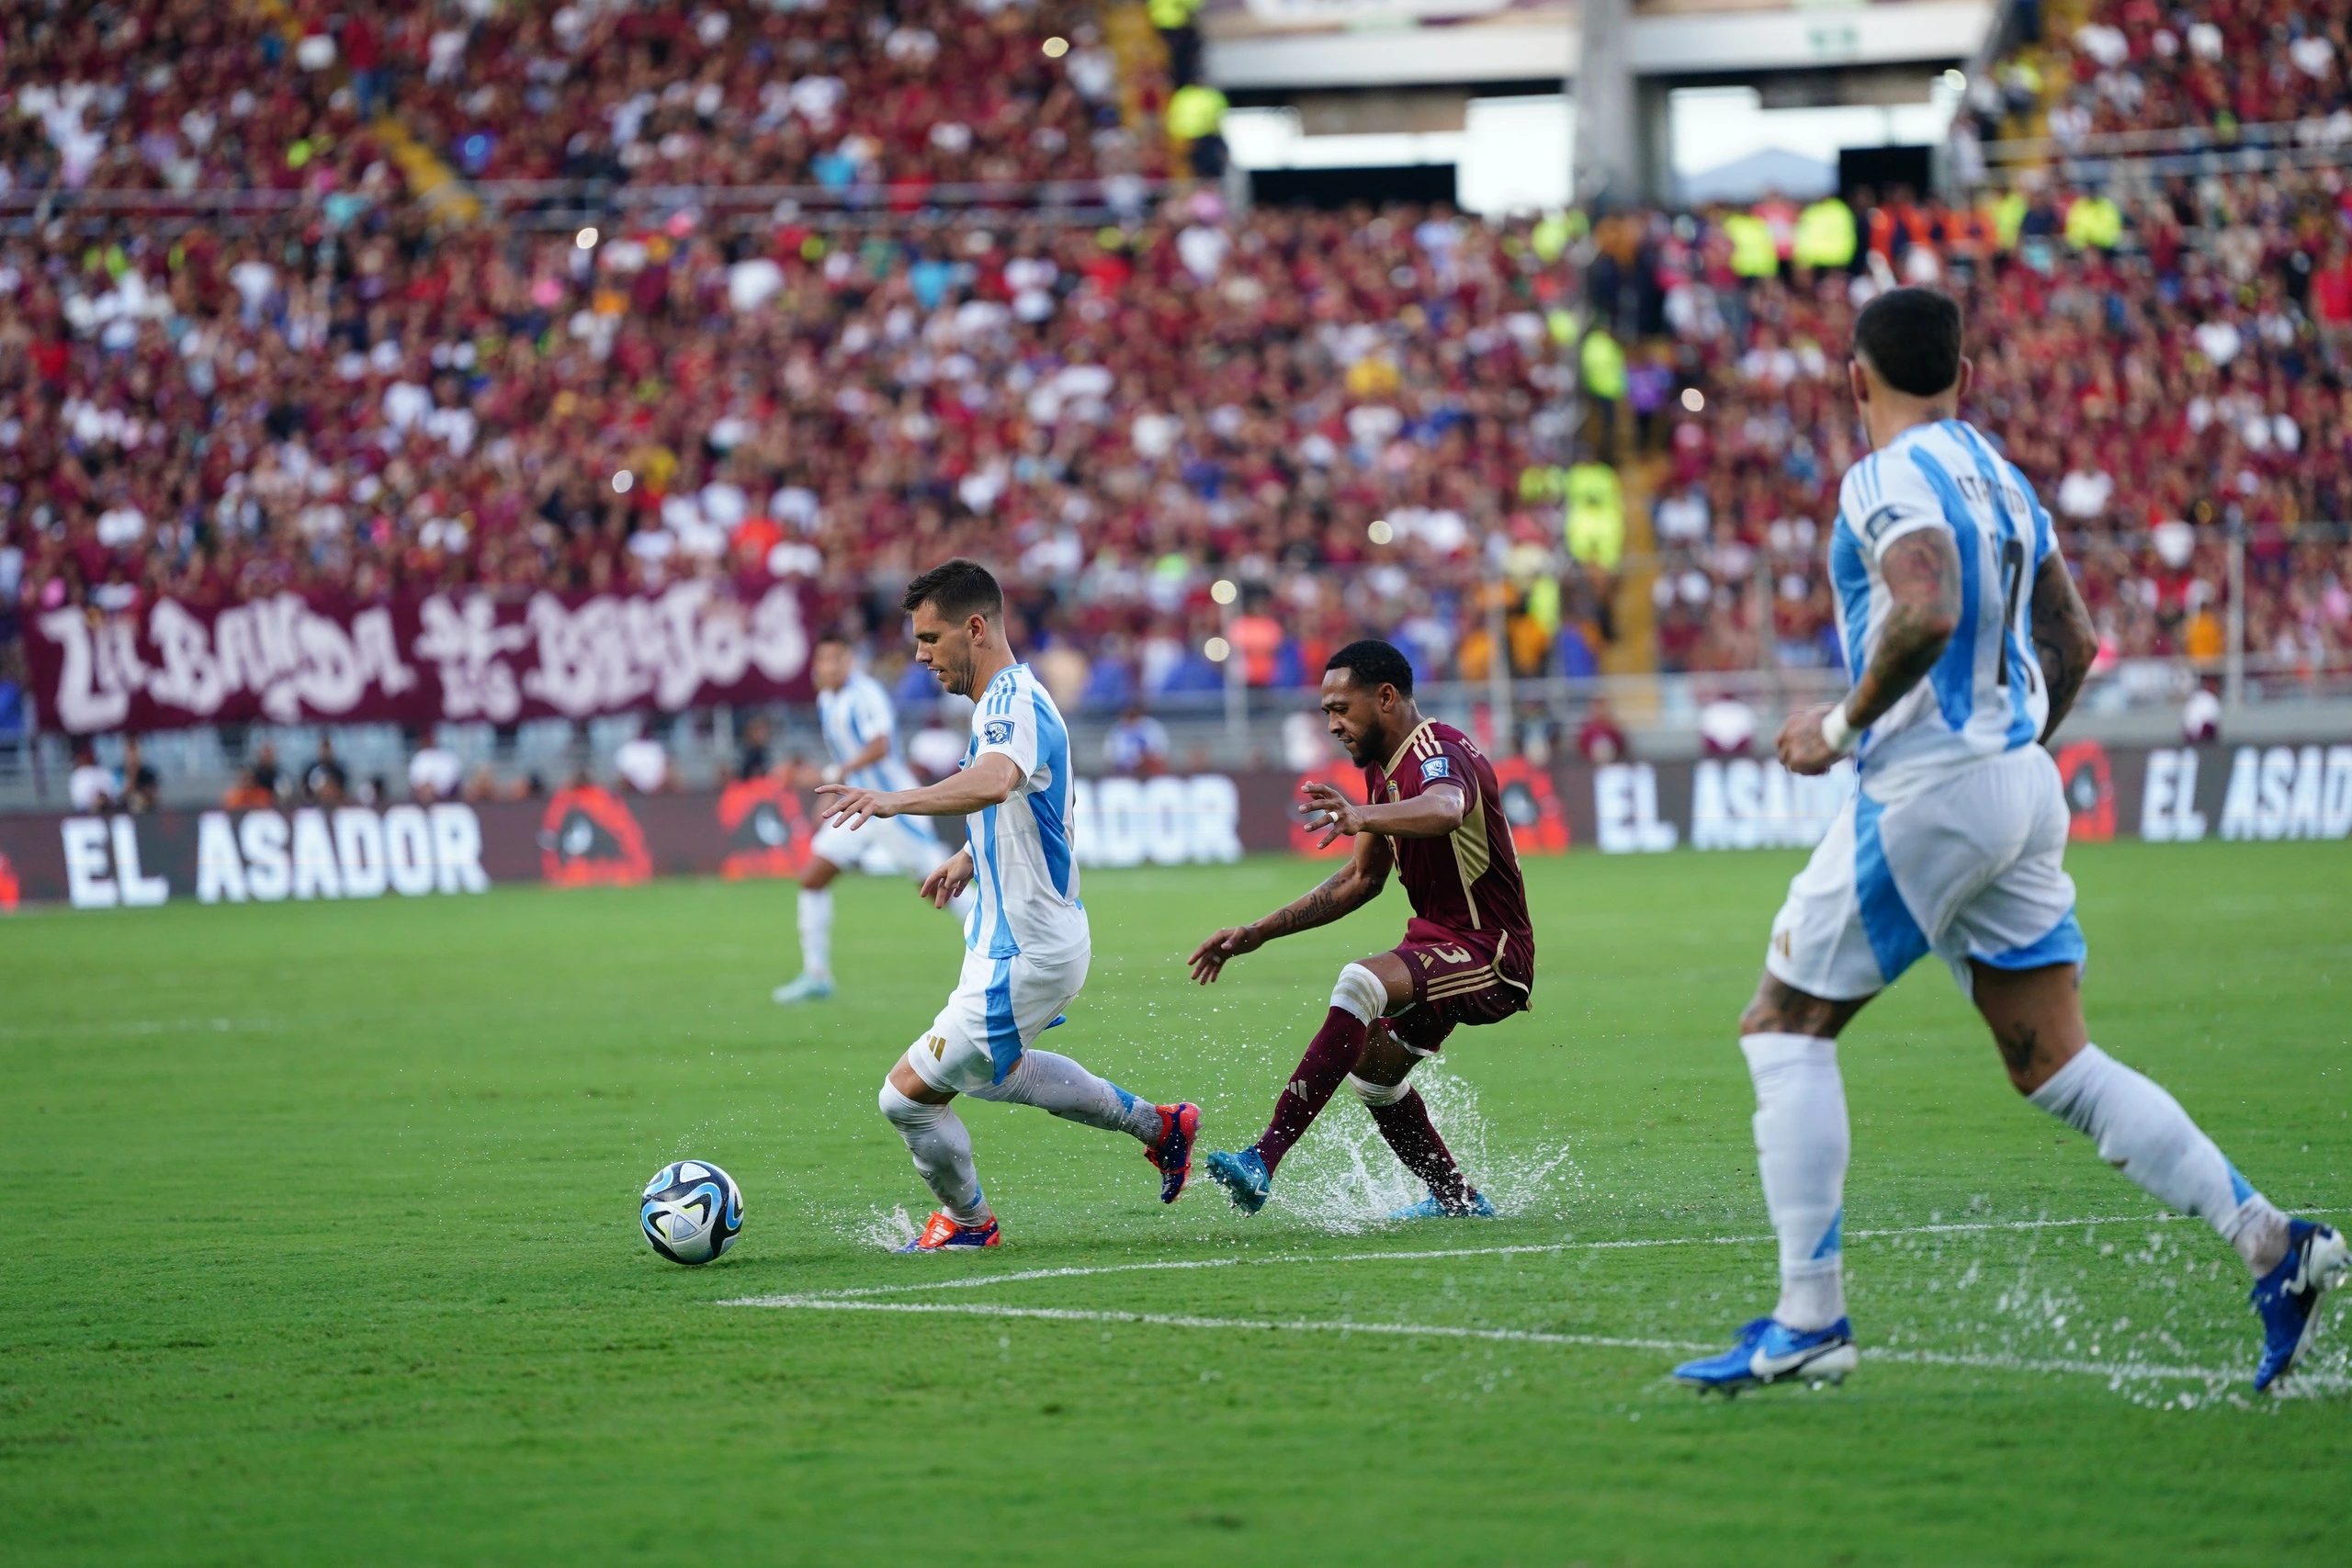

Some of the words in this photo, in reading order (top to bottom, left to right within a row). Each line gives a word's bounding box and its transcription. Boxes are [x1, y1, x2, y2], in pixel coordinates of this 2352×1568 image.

[147, 591, 419, 724] BANDA
[1594, 761, 1679, 854] EL
[2140, 748, 2207, 842] EL
[2219, 745, 2352, 841] ASAD
[62, 815, 169, 909] EL
[196, 802, 490, 904] ASADOR
